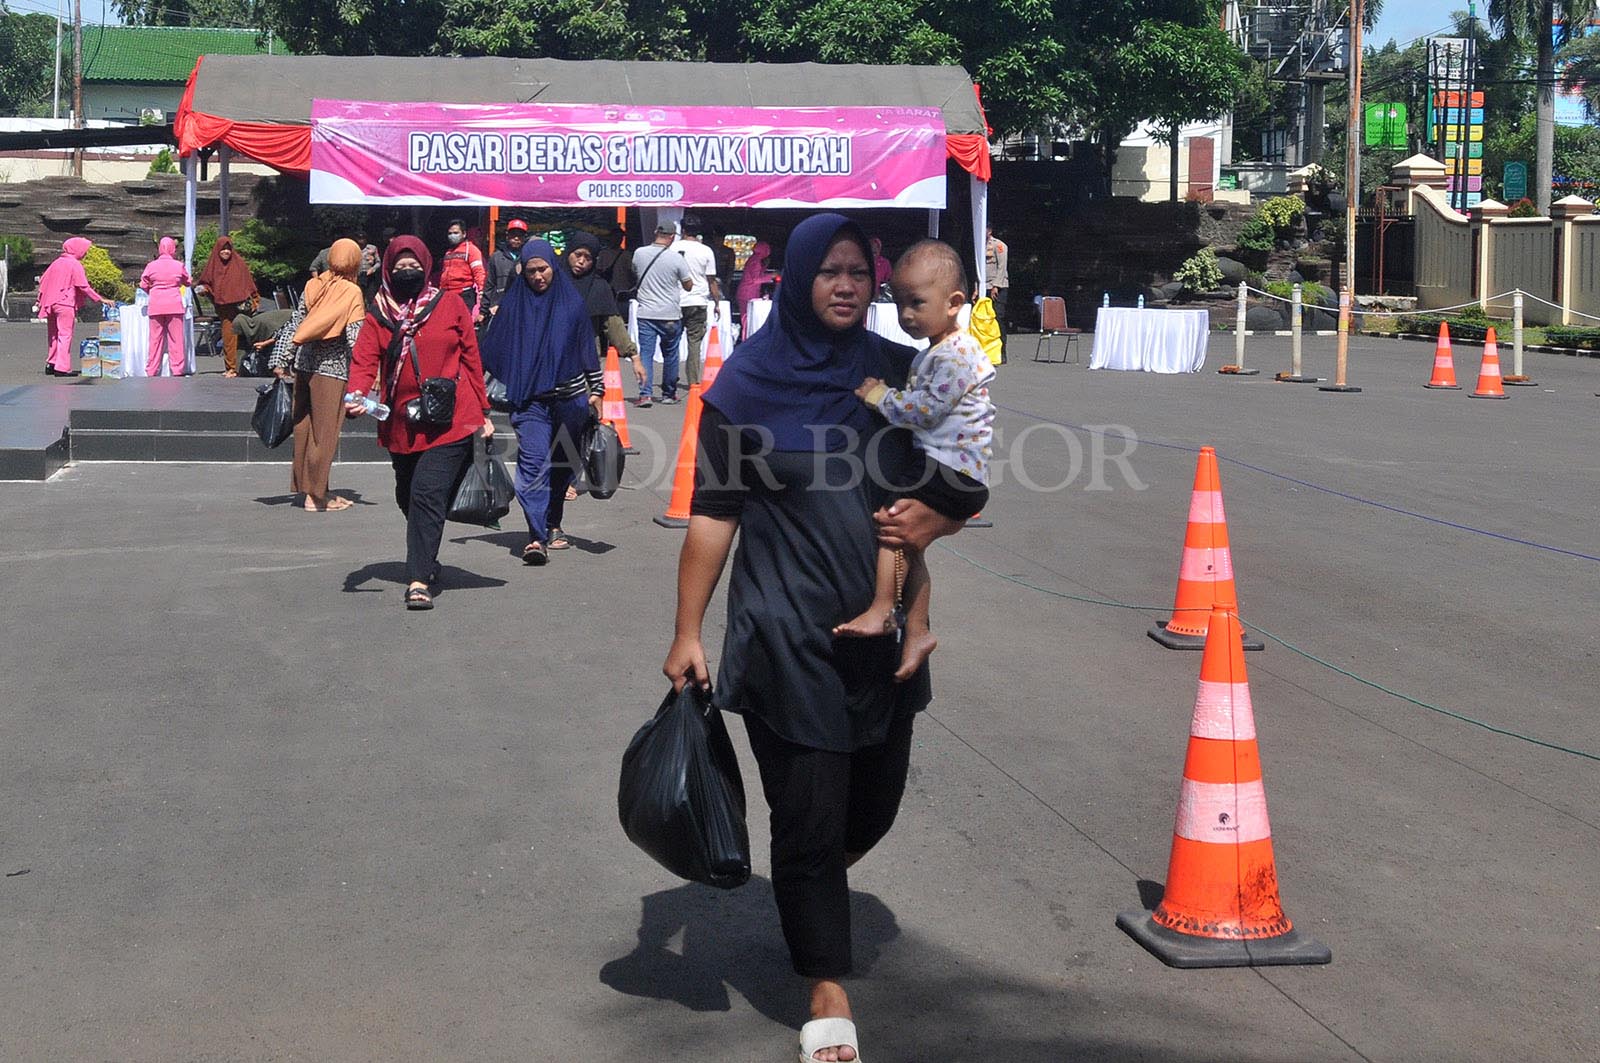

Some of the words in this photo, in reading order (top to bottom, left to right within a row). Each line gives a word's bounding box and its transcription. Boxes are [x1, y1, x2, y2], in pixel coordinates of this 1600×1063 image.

[409, 133, 505, 172] PASAR
[509, 134, 603, 173] BERAS
[607, 135, 630, 173] &
[633, 135, 745, 173] MINYAK
[748, 136, 850, 174] MURAH
[588, 183, 632, 198] POLRES
[635, 183, 674, 198] BOGOR
